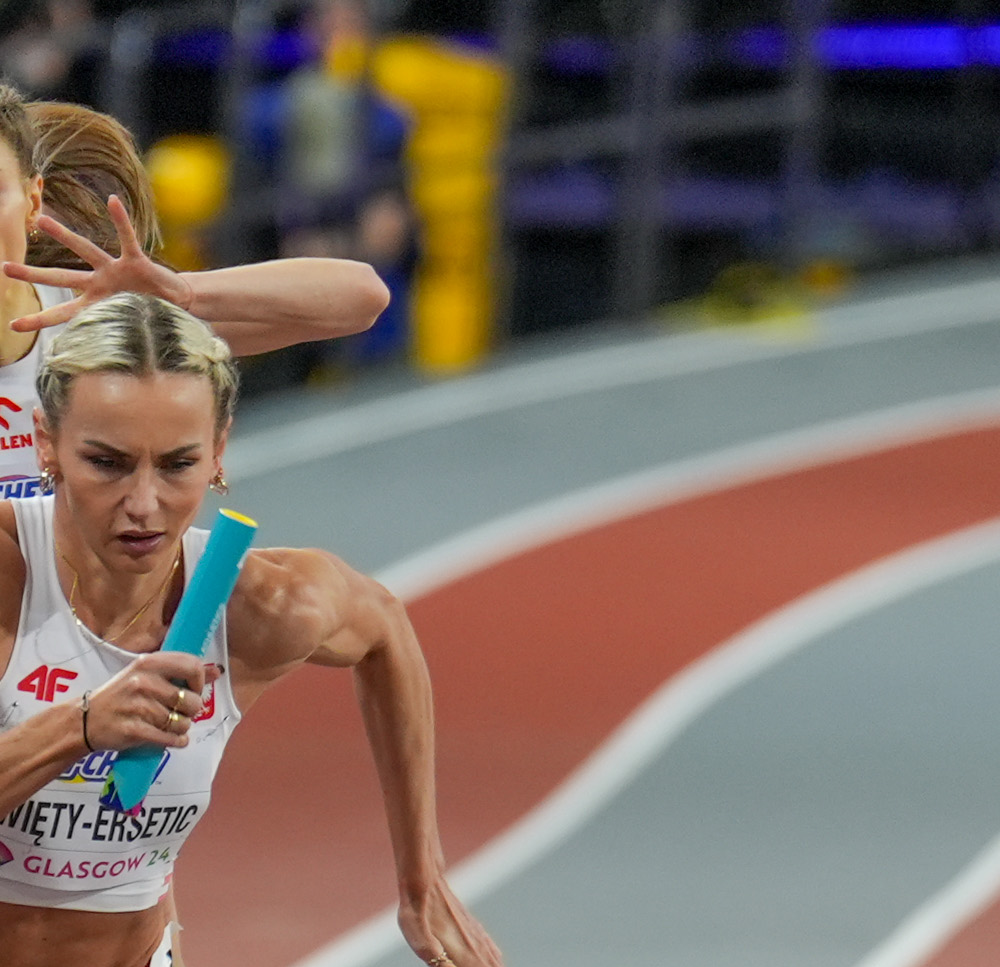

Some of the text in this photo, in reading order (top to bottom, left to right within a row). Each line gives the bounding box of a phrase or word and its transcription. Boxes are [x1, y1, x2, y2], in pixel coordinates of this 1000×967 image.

[17, 664, 78, 702] 4F
[23, 846, 171, 879] GLASGOW 24
